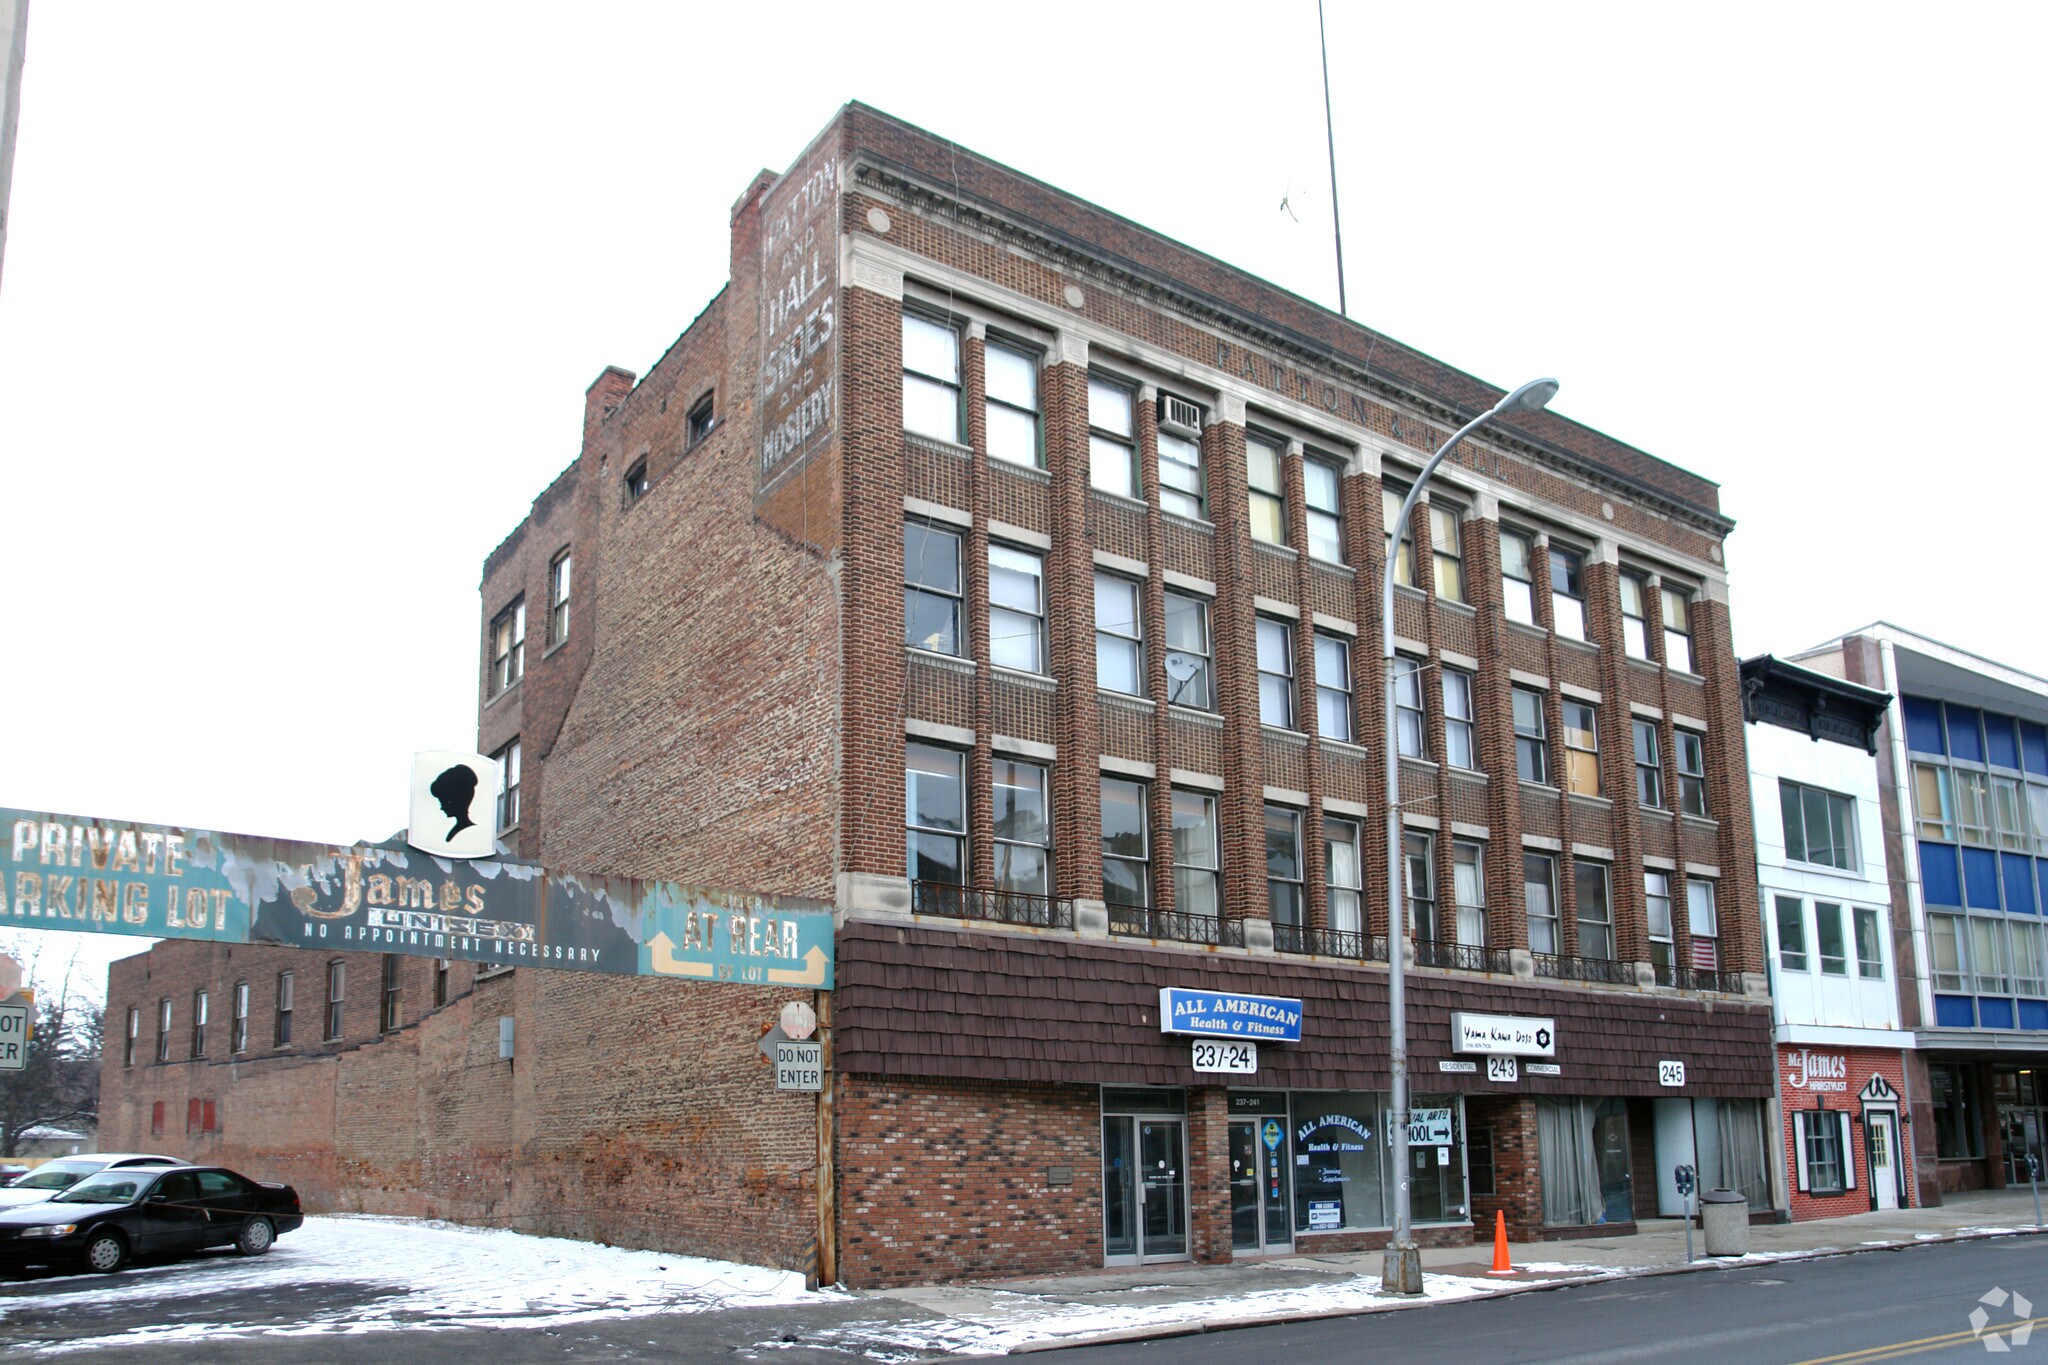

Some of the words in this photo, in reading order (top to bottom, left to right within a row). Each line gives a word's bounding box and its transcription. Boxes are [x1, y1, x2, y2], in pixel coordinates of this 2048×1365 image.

[768, 157, 835, 256] PATTON
[781, 225, 815, 274] AND
[769, 251, 828, 336] HALL
[764, 296, 834, 396] SHOES
[779, 367, 814, 409] AND
[762, 376, 833, 474] HOSIERY
[1217, 341, 1367, 425] PATTON
[1424, 427, 1508, 481] HALL
[11, 818, 185, 877] PRIVATE
[290, 851, 487, 919] James
[166, 884, 233, 931] LOT
[304, 922, 327, 938] NO
[344, 925, 481, 952] APPOINTMENT
[495, 938, 601, 962] NECESSARY
[683, 911, 718, 951] AT
[730, 913, 798, 960] REAR
[718, 963, 733, 979] OF
[742, 966, 763, 981] LOT
[1174, 999, 1207, 1016] ALL
[1213, 998, 1300, 1027] AMERICAN
[1190, 1016, 1228, 1031] Health
[1232, 1020, 1243, 1031] &
[1247, 1021, 1285, 1035] Fitness
[778, 1049, 794, 1062] DO
[797, 1050, 820, 1063] NOT
[1441, 1062, 1476, 1071] RESIDENTIAL
[1490, 1057, 1515, 1078] 243
[1526, 1064, 1560, 1074] COMMERCIAL
[1788, 1048, 1846, 1088] James
[780, 1069, 819, 1084] ENTER
[1661, 1065, 1683, 1082] 245
[1809, 1081, 1847, 1092] HAIRSTYLIST
[1235, 1098, 1260, 1106] 237-241
[1427, 1110, 1449, 1121] ARTS
[1298, 1121, 1317, 1141] ALL
[1319, 1115, 1371, 1140] AMERICAN
[1308, 1143, 1330, 1151] Health
[1332, 1143, 1339, 1151] &
[1341, 1143, 1364, 1151] Fitness
